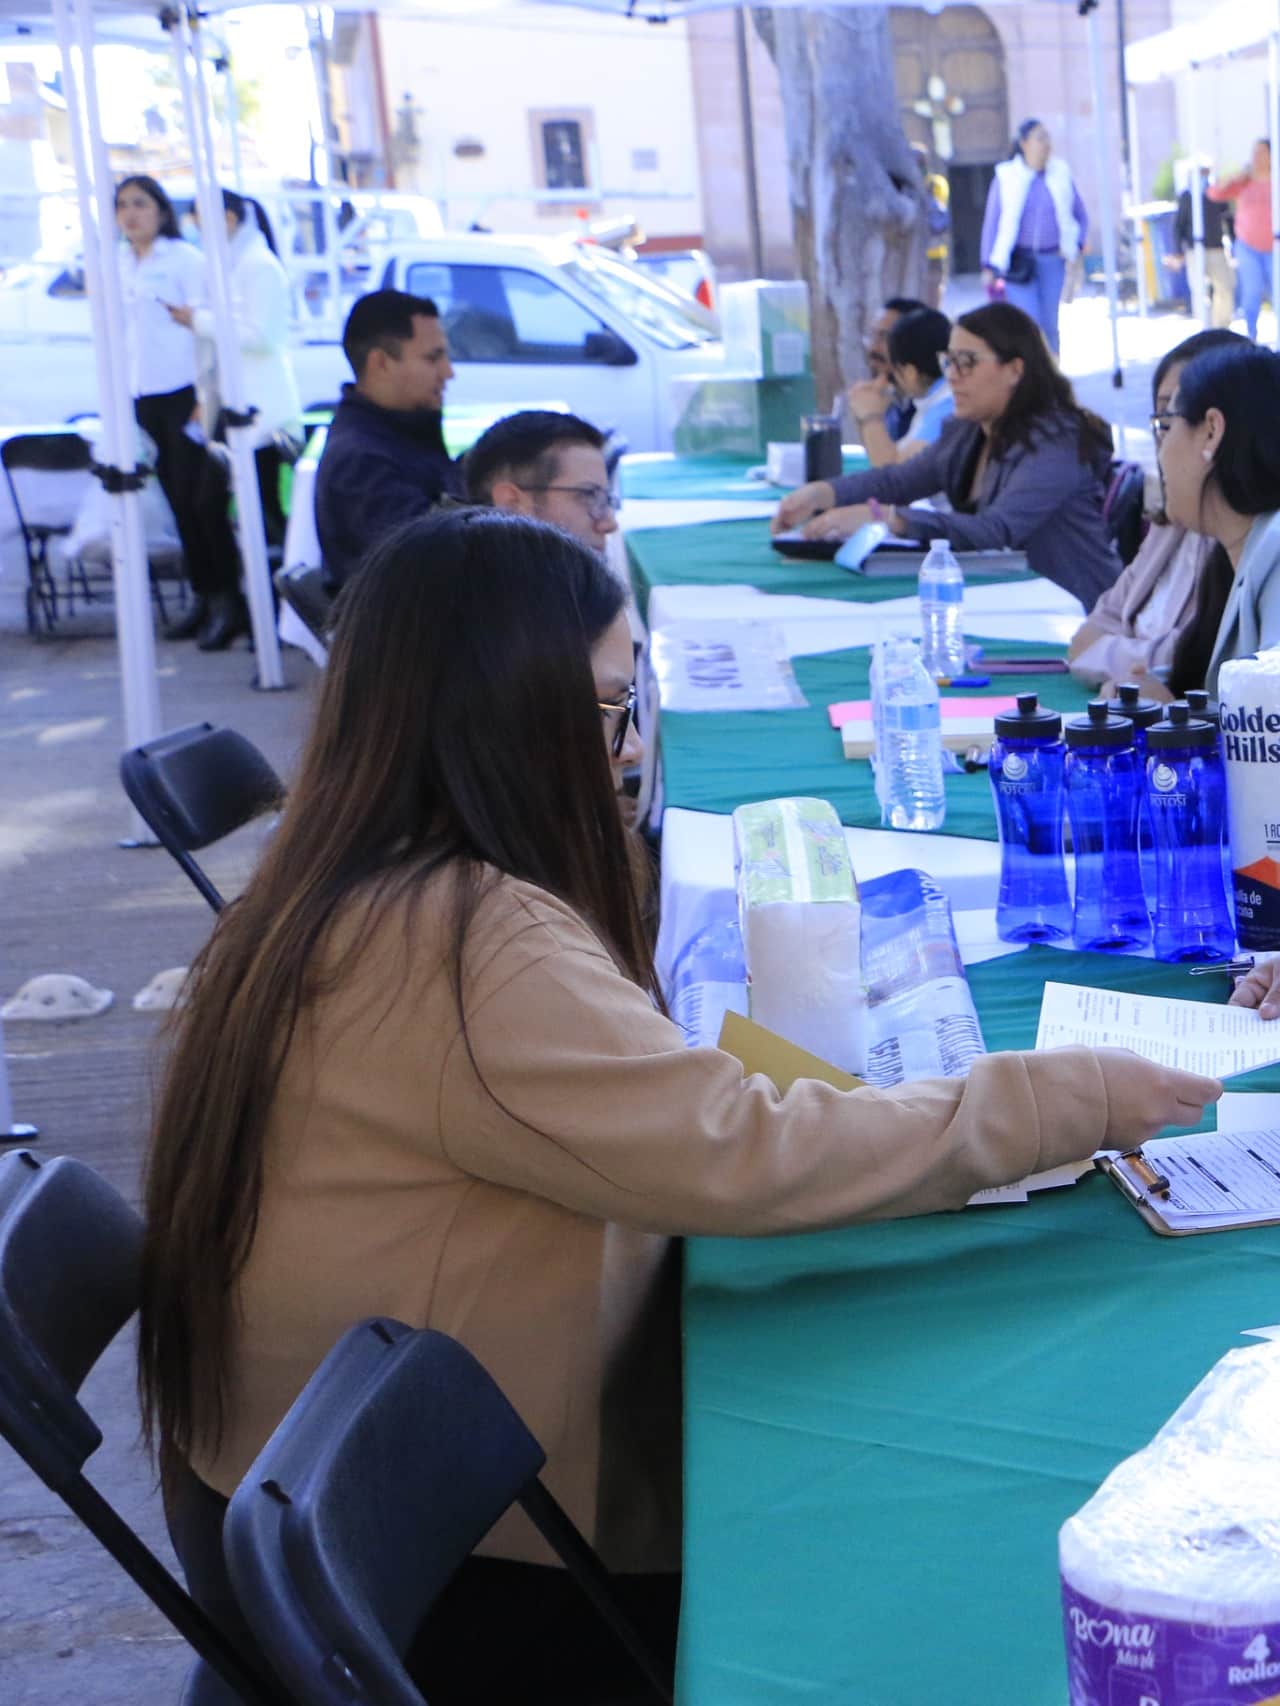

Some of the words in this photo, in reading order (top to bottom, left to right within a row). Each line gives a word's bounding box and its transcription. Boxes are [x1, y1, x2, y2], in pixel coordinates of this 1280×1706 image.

[1264, 823, 1269, 838] 1
[1249, 890, 1262, 905] de
[1243, 1633, 1271, 1662] 4
